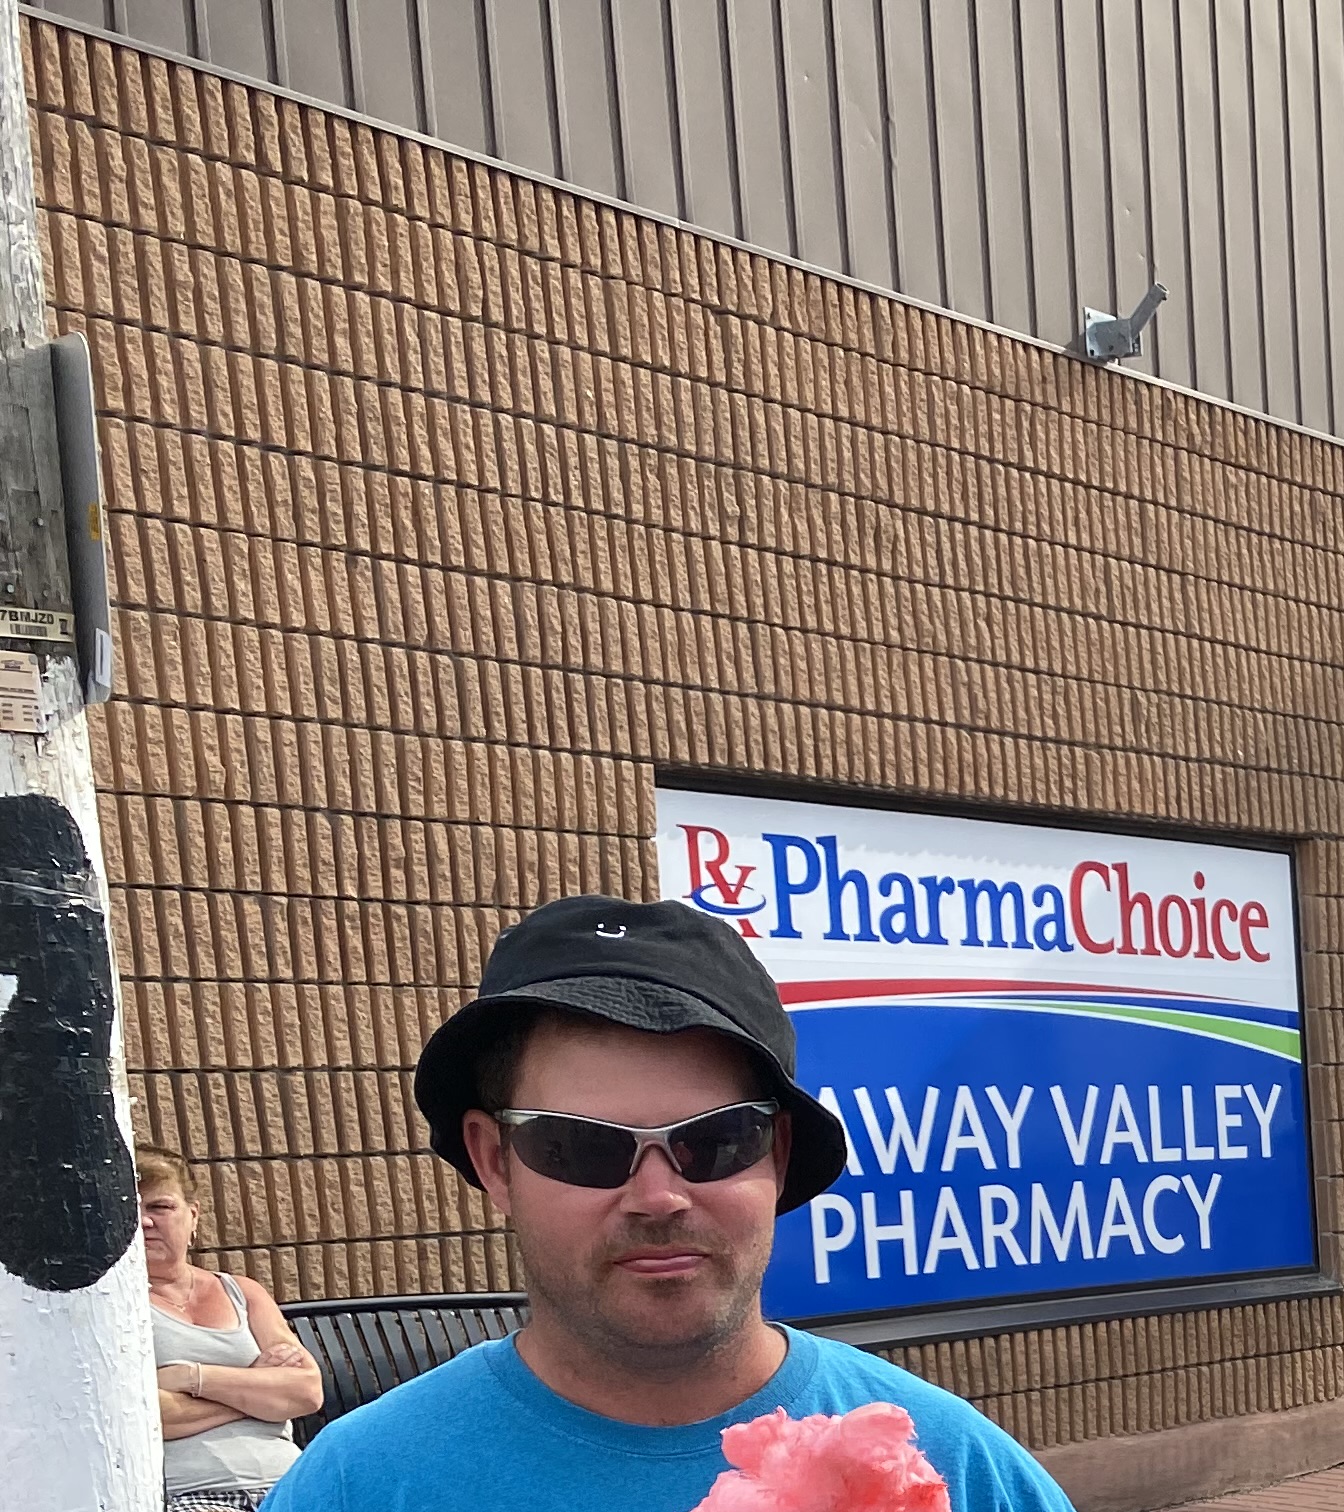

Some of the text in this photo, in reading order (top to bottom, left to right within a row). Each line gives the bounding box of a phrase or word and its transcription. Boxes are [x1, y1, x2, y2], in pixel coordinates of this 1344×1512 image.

[761, 832, 1272, 963] PharmaChoice
[812, 1082, 1283, 1177] AWAY VALLEY
[809, 1173, 1223, 1286] PHARMACY
